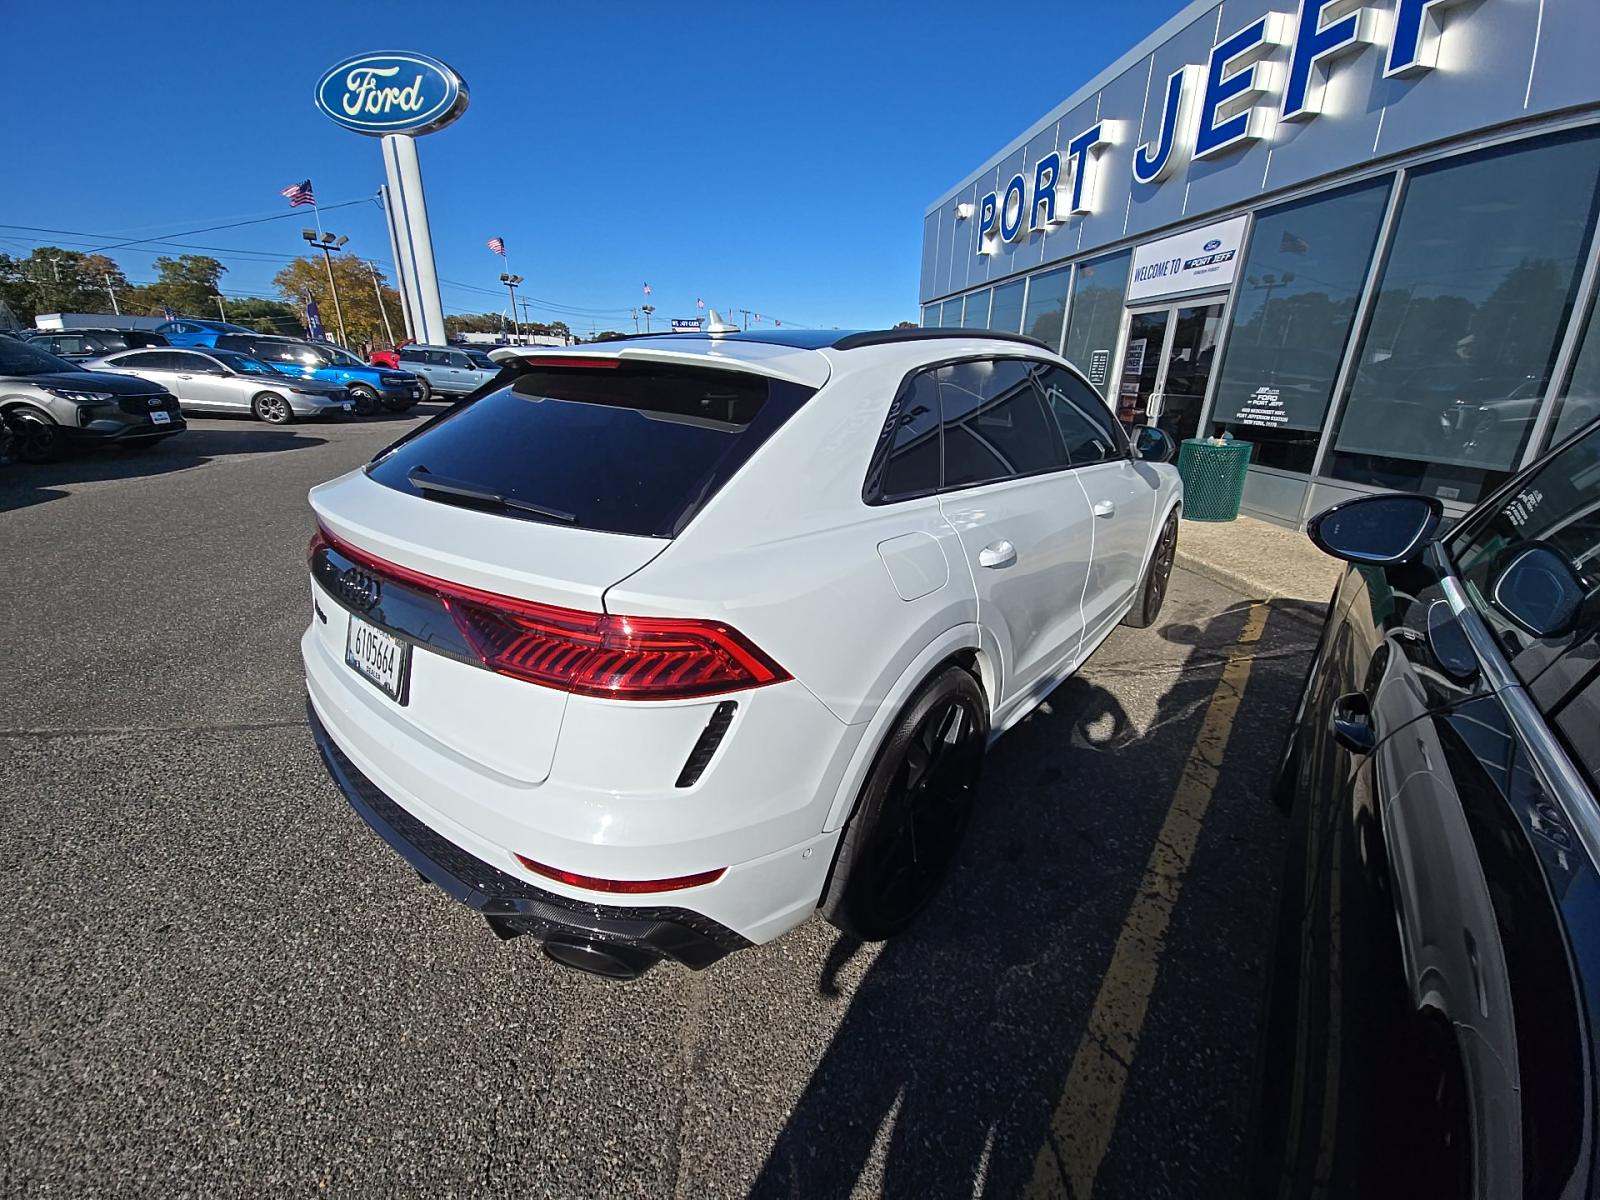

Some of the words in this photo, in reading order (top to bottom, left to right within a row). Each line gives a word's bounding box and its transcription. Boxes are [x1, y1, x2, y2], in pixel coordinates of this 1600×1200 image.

[342, 66, 424, 115] Ford
[976, 119, 1103, 256] PORT
[1134, 259, 1170, 282] WELCOME
[1169, 257, 1182, 276] TO
[1190, 256, 1212, 268] PORT
[1212, 251, 1232, 263] JEFF
[1257, 394, 1278, 402] FORD
[356, 626, 395, 679] 6105664
